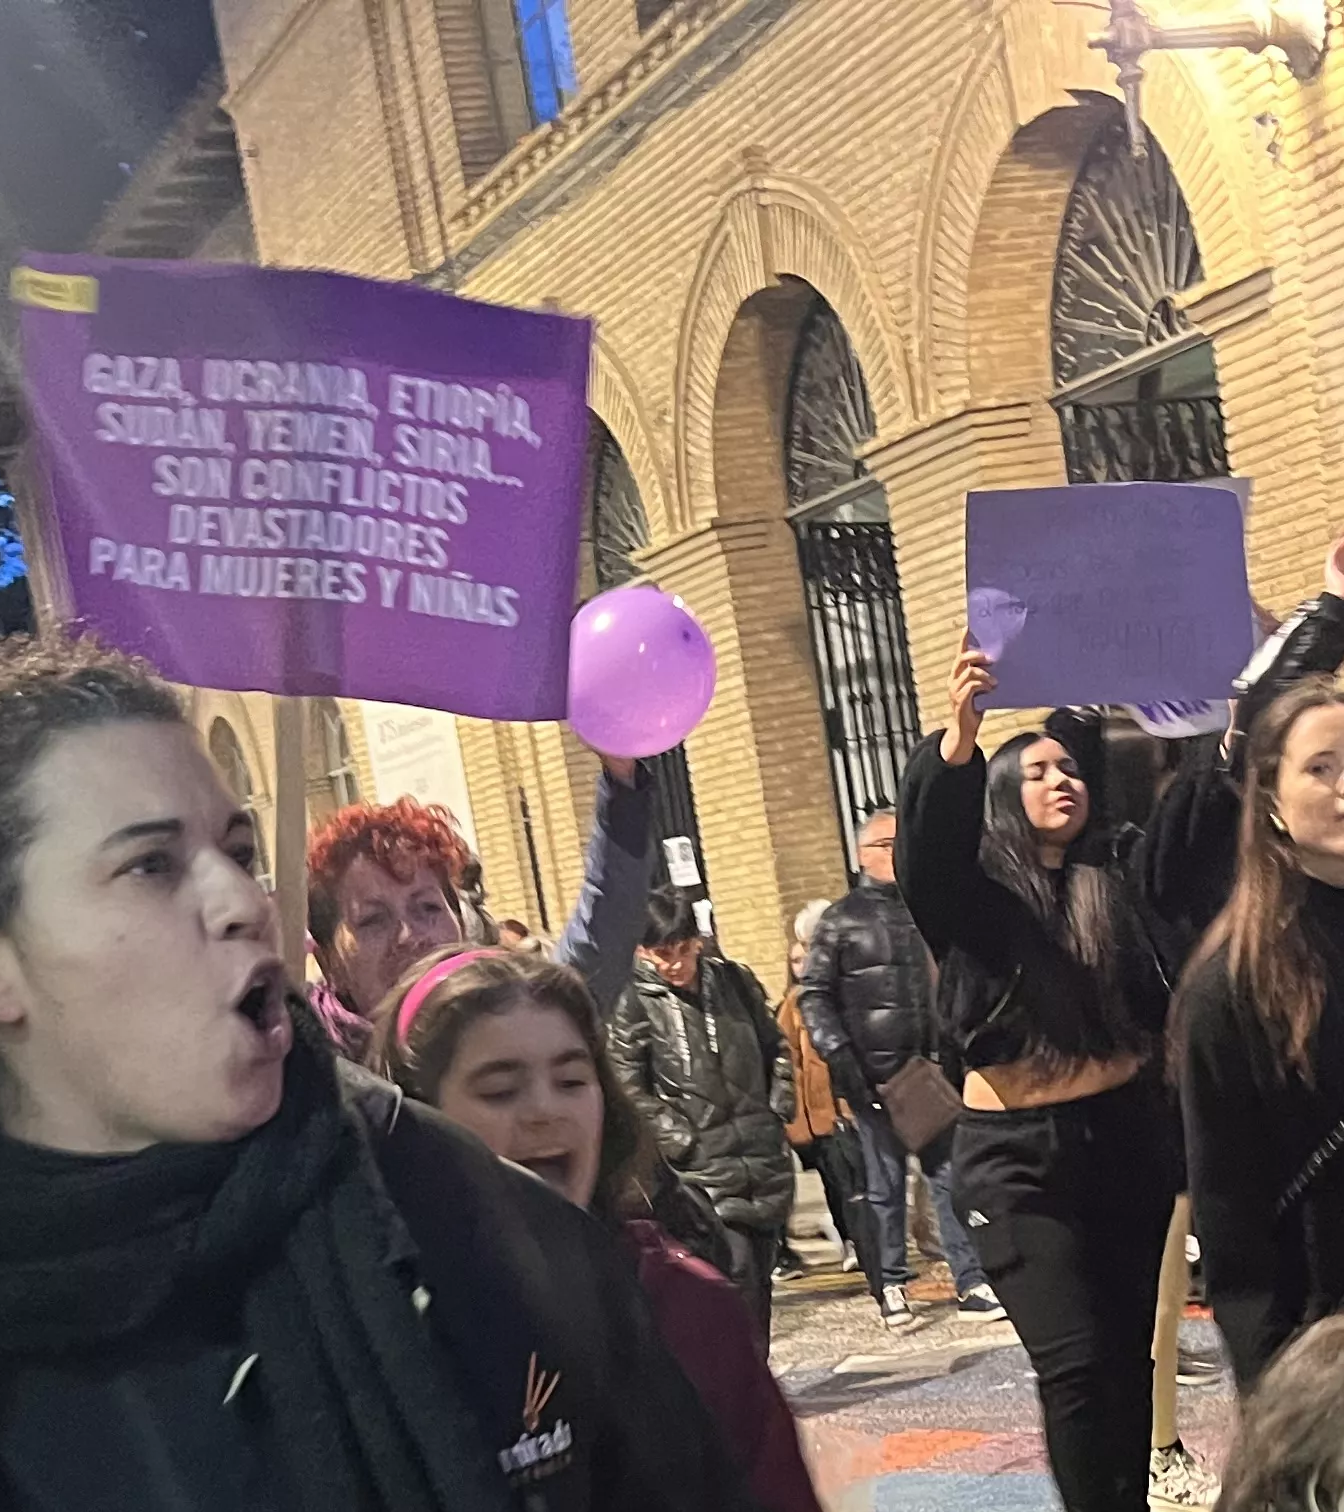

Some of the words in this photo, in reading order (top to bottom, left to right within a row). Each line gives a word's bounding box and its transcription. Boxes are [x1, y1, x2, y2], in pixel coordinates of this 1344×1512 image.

[83, 354, 197, 405] GAZA,
[201, 359, 379, 419] UCRANIA,
[243, 410, 382, 464] YEMEN,
[152, 455, 232, 498] SON
[239, 457, 468, 524] CONFLICTOS
[169, 504, 450, 568] DEVASTADORES
[88, 538, 190, 592] PARA
[199, 555, 367, 604] MUJERES
[377, 572, 402, 609] Y
[408, 570, 520, 628] NIÑAS
